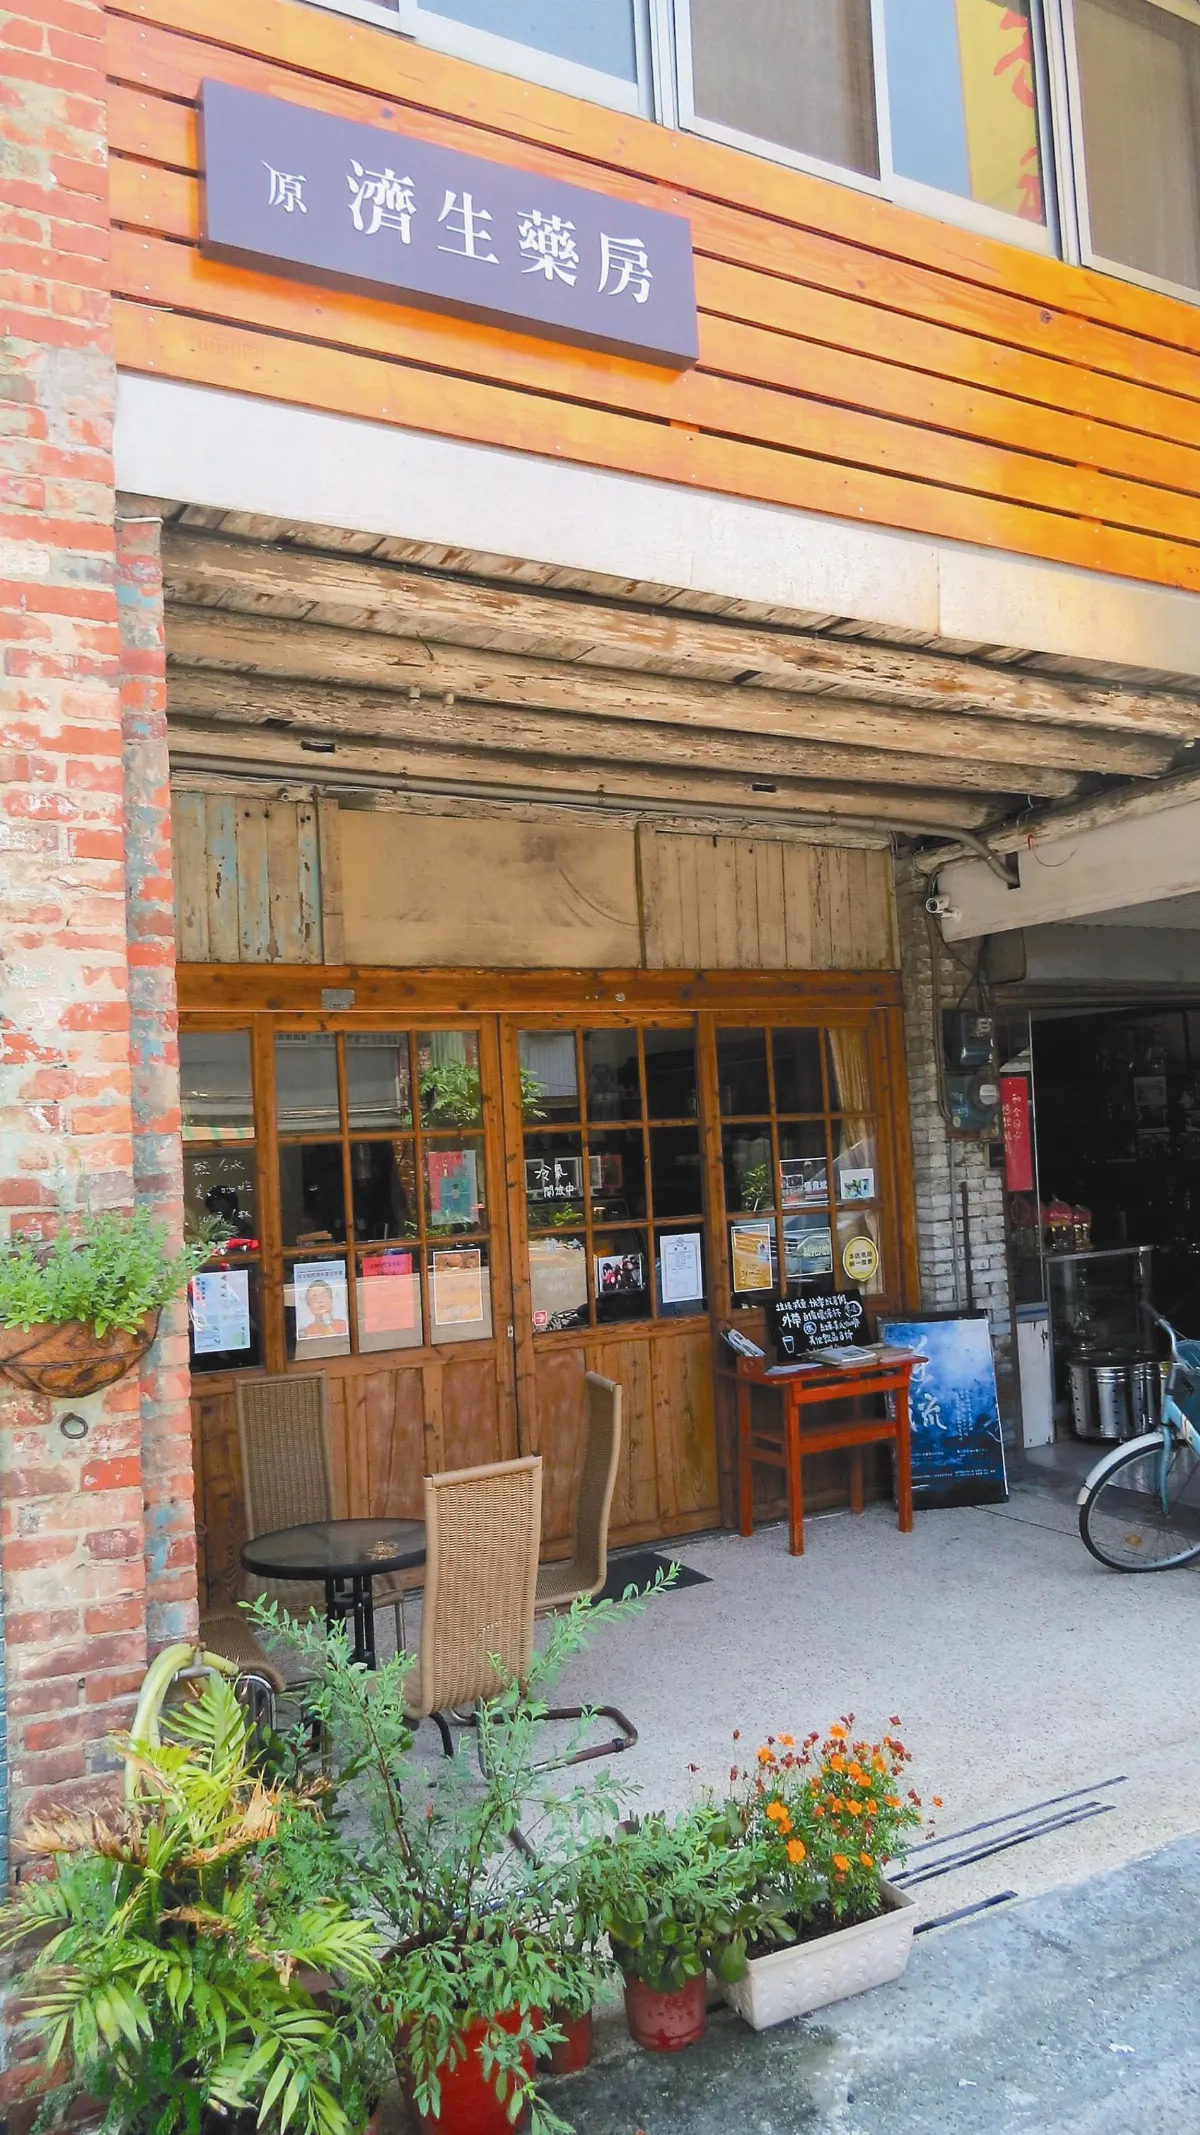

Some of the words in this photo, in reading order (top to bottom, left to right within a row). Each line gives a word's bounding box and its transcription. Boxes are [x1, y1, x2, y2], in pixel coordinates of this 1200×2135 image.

[261, 160, 307, 214] 原
[347, 158, 654, 304] 濟生藥房
[534, 1163, 568, 1181] 冷氣
